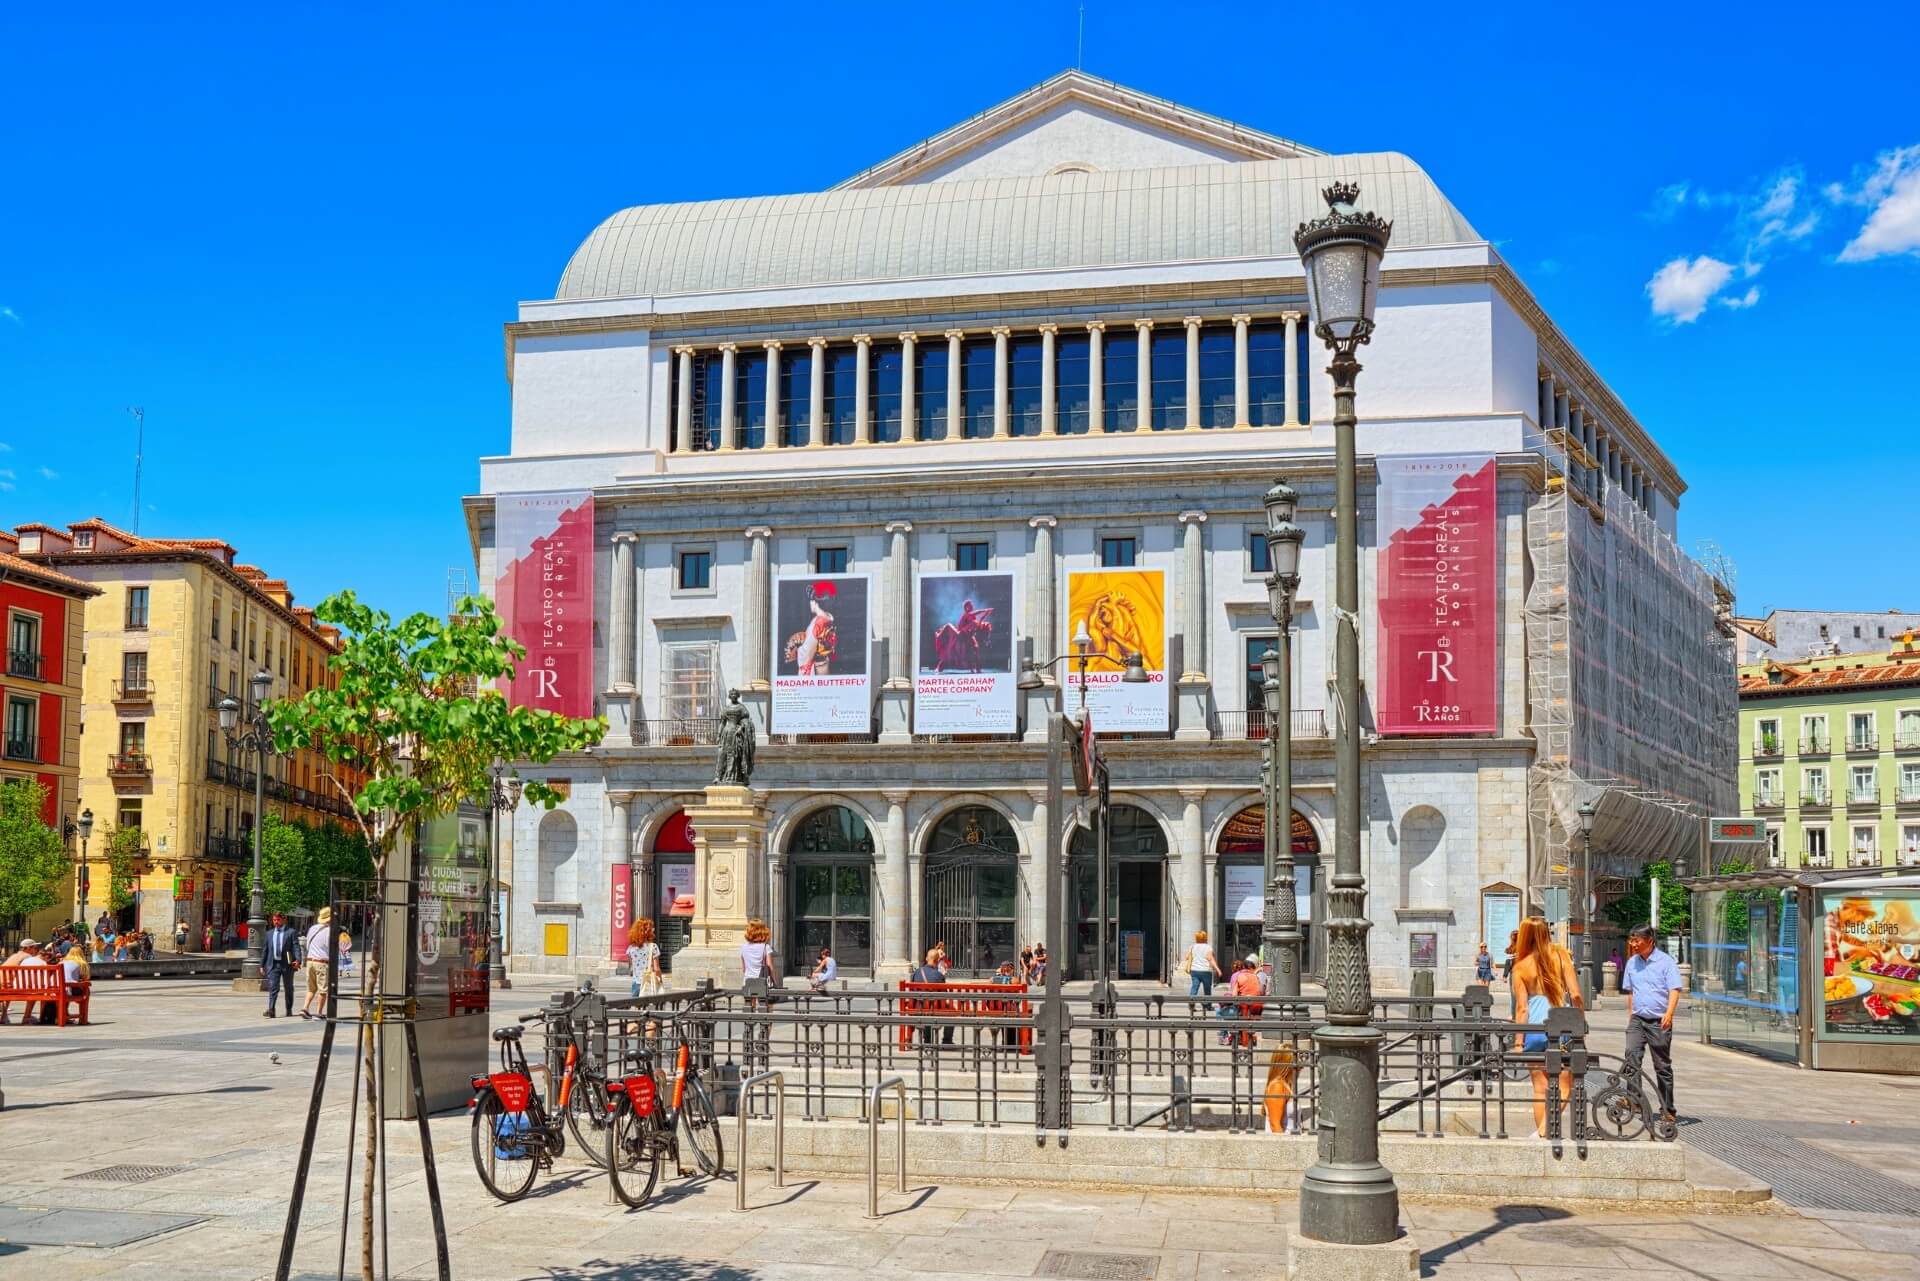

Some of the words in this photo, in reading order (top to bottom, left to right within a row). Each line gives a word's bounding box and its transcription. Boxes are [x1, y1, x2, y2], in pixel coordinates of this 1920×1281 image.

[1436, 509, 1448, 553] REAL
[544, 543, 553, 581] REAL
[1436, 561, 1448, 626] TEATRO
[544, 588, 553, 647] TEATRO
[776, 679, 815, 687] MADAMA
[817, 678, 866, 687] BUTTERFLY
[918, 678, 955, 686] MARTHA
[957, 677, 995, 685] GRAHAM
[1068, 675, 1081, 683] EL
[1084, 674, 1119, 683] GALLO
[950, 686, 993, 694] COMPANY
[1434, 705, 1460, 713] 200
[1434, 713, 1460, 721] AÑOS
[419, 865, 430, 877] LA
[432, 866, 462, 879] CIUDAD
[419, 880, 437, 892] QUE
[615, 882, 626, 929] COSTA
